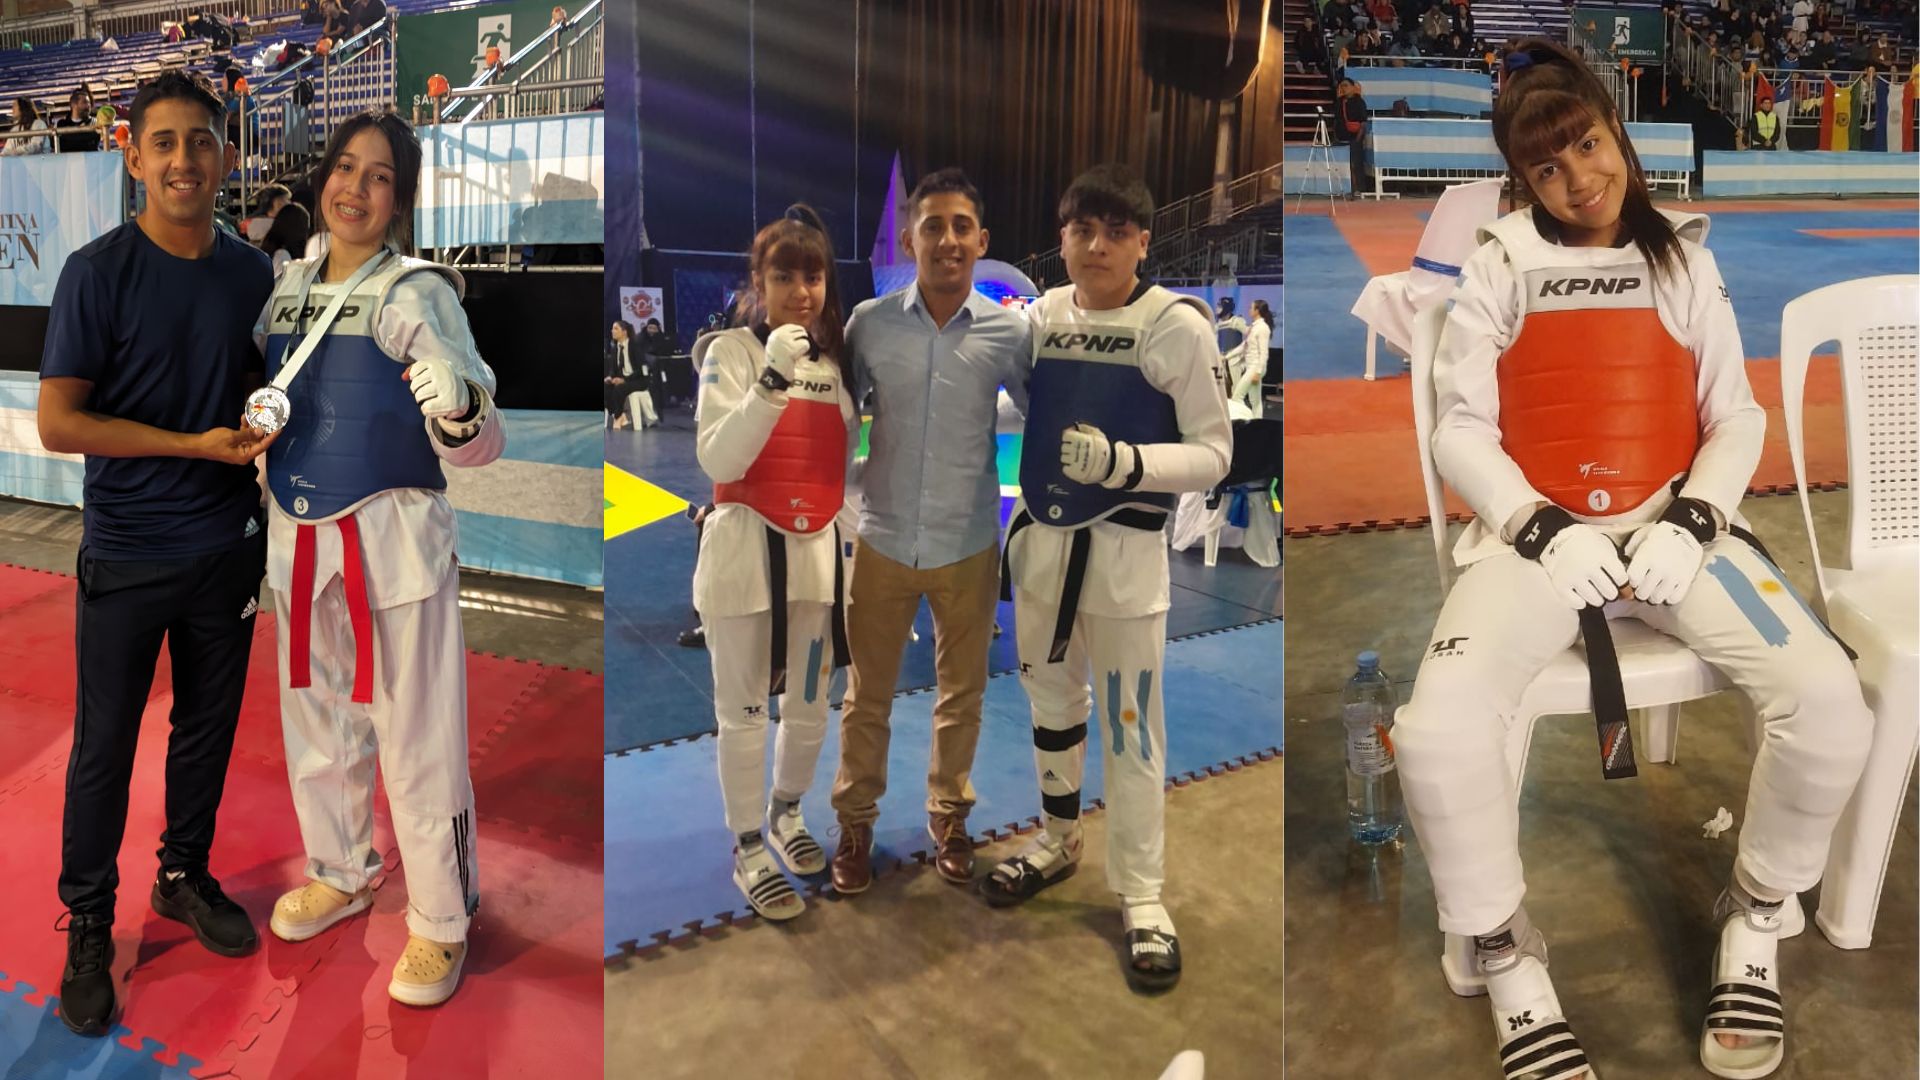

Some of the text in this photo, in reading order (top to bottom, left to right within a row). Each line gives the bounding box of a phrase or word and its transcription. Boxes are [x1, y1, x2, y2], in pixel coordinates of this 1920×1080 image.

[0, 233, 40, 271] EN
[1539, 277, 1641, 298] KPNP
[1043, 332, 1136, 354] KPNP
[790, 379, 832, 393] PNP
[298, 499, 304, 512] 3
[1131, 941, 1169, 957] PUMA
